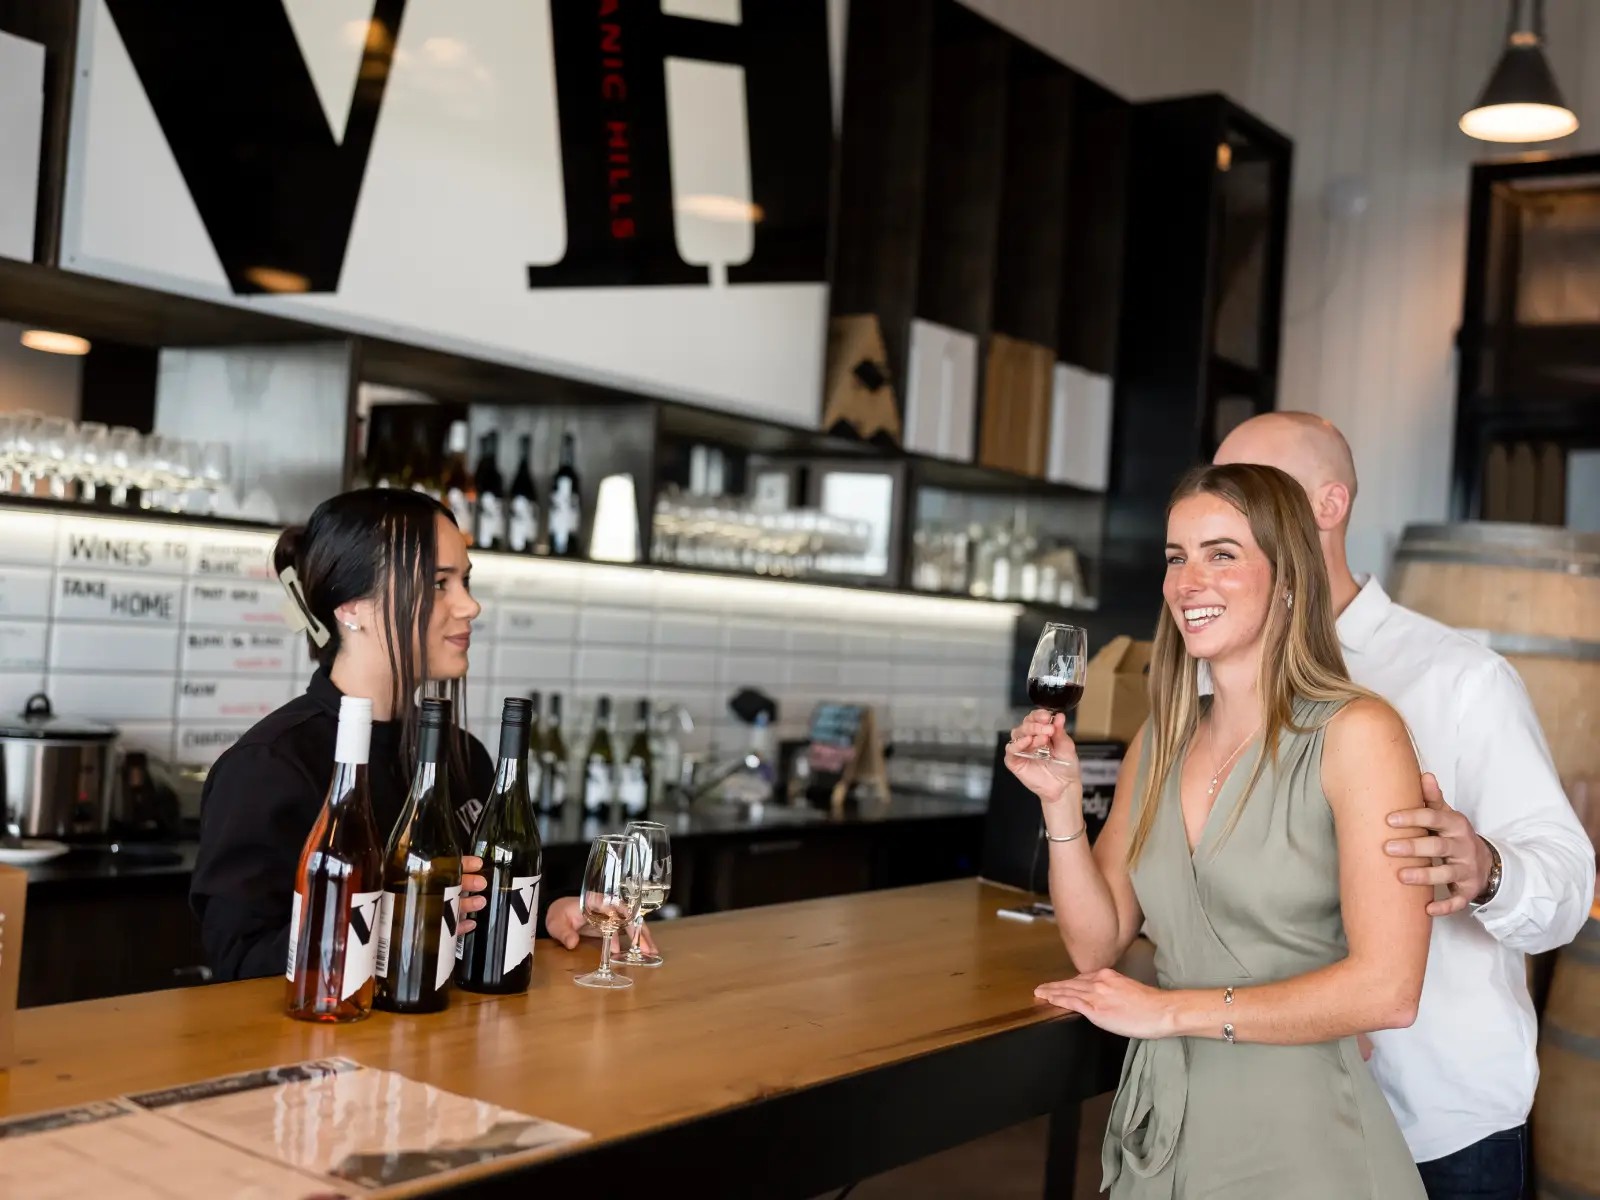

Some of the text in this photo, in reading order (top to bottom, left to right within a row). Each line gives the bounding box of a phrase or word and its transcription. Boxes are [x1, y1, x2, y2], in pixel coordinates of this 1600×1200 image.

[607, 121, 635, 238] HILLS
[69, 532, 188, 567] WINES TO
[63, 577, 173, 620] TAKE HOME
[350, 895, 382, 946] V
[511, 881, 540, 926] V
